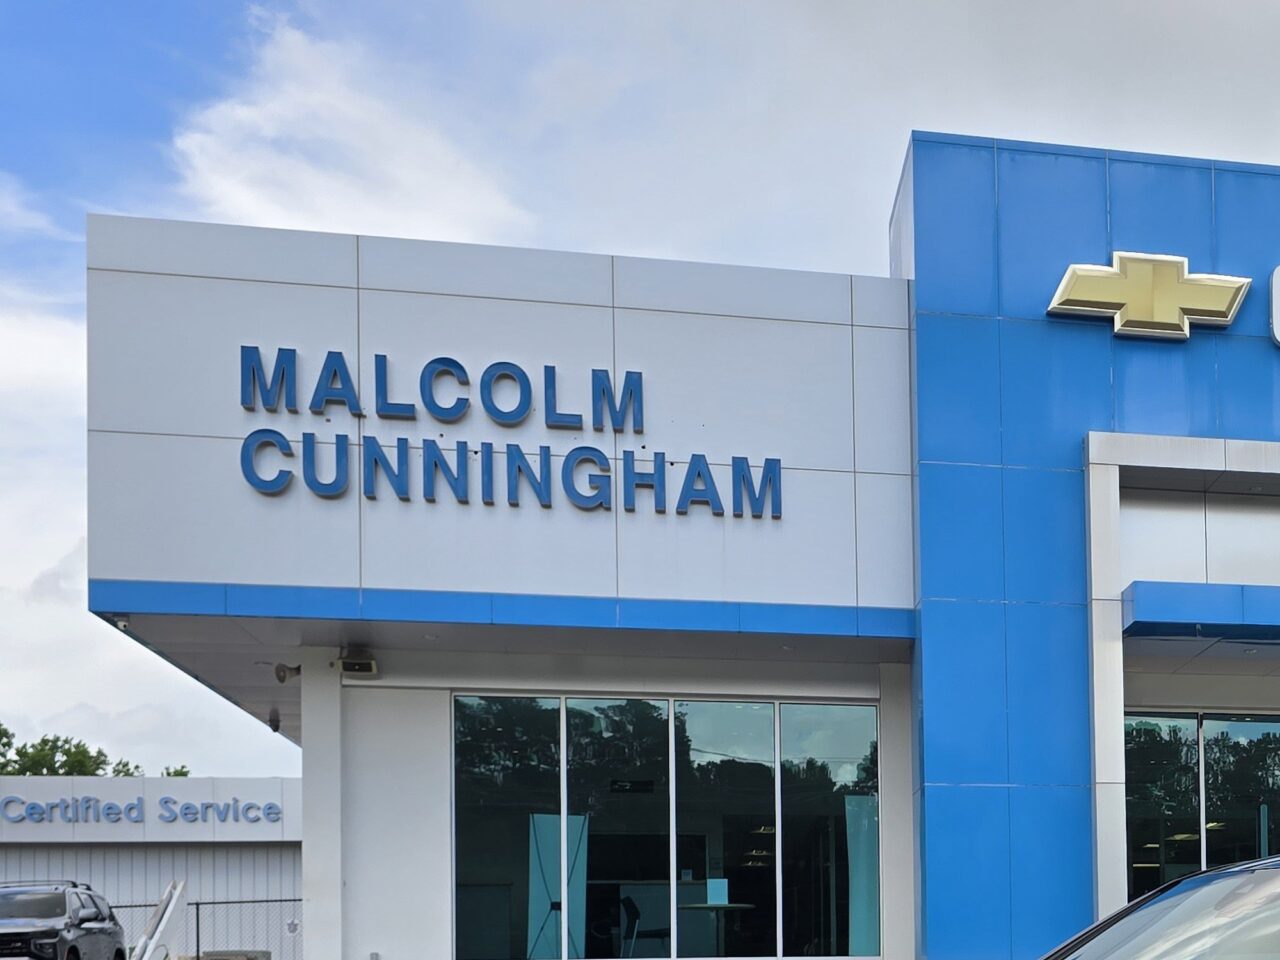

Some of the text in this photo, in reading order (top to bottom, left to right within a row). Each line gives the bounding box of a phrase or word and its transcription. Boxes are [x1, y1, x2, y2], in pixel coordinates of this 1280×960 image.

[240, 345, 644, 434] MALCOLM
[240, 429, 782, 519] CUNNINGHAM
[1, 796, 283, 823] Certified Service
